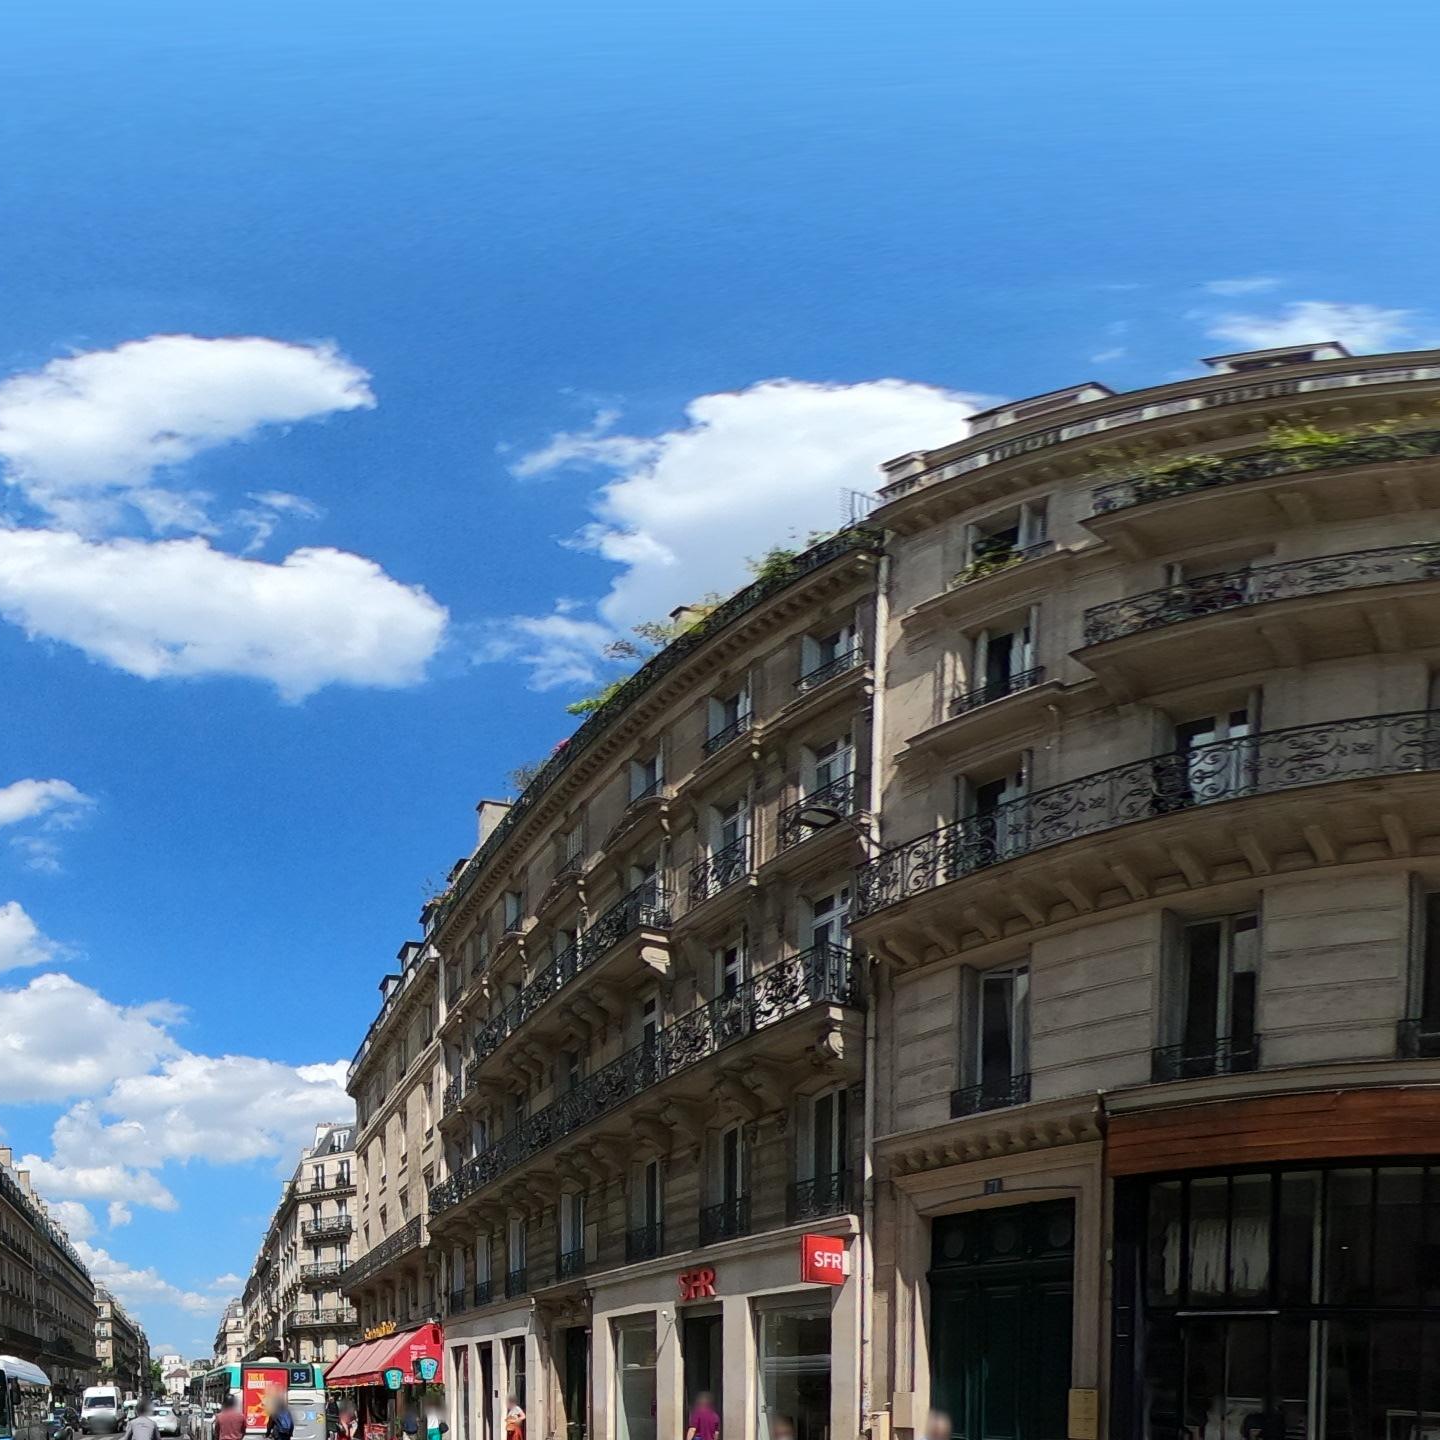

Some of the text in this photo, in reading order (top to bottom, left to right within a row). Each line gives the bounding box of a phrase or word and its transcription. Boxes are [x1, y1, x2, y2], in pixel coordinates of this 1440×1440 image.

[814, 1250, 843, 1270] SFR
[676, 1266, 718, 1301] SFR
[293, 1371, 307, 1381] 95
